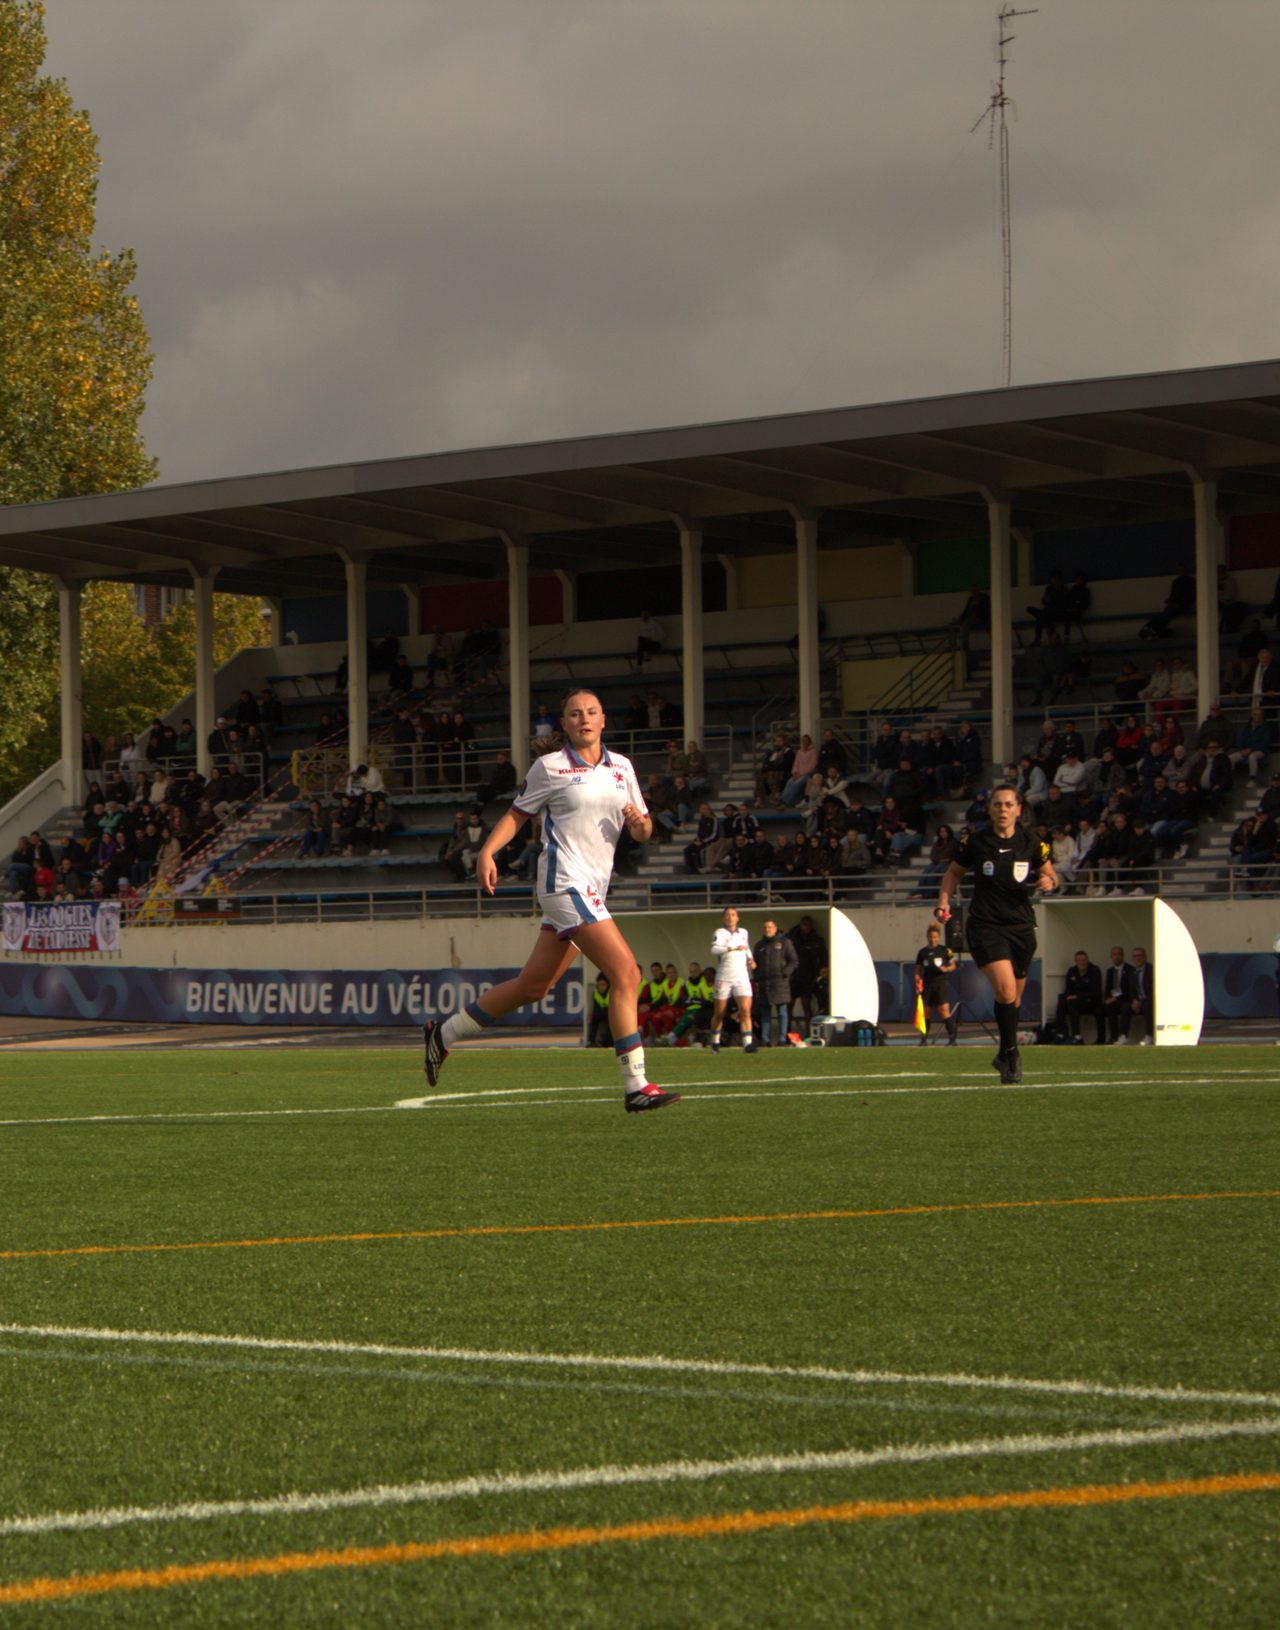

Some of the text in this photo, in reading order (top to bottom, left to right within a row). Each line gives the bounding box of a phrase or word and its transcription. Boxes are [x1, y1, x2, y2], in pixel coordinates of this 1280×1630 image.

[186, 981, 333, 1015] BIENVENUE
[341, 982, 379, 1015] AU
[387, 975, 556, 1016] VÉLODE
